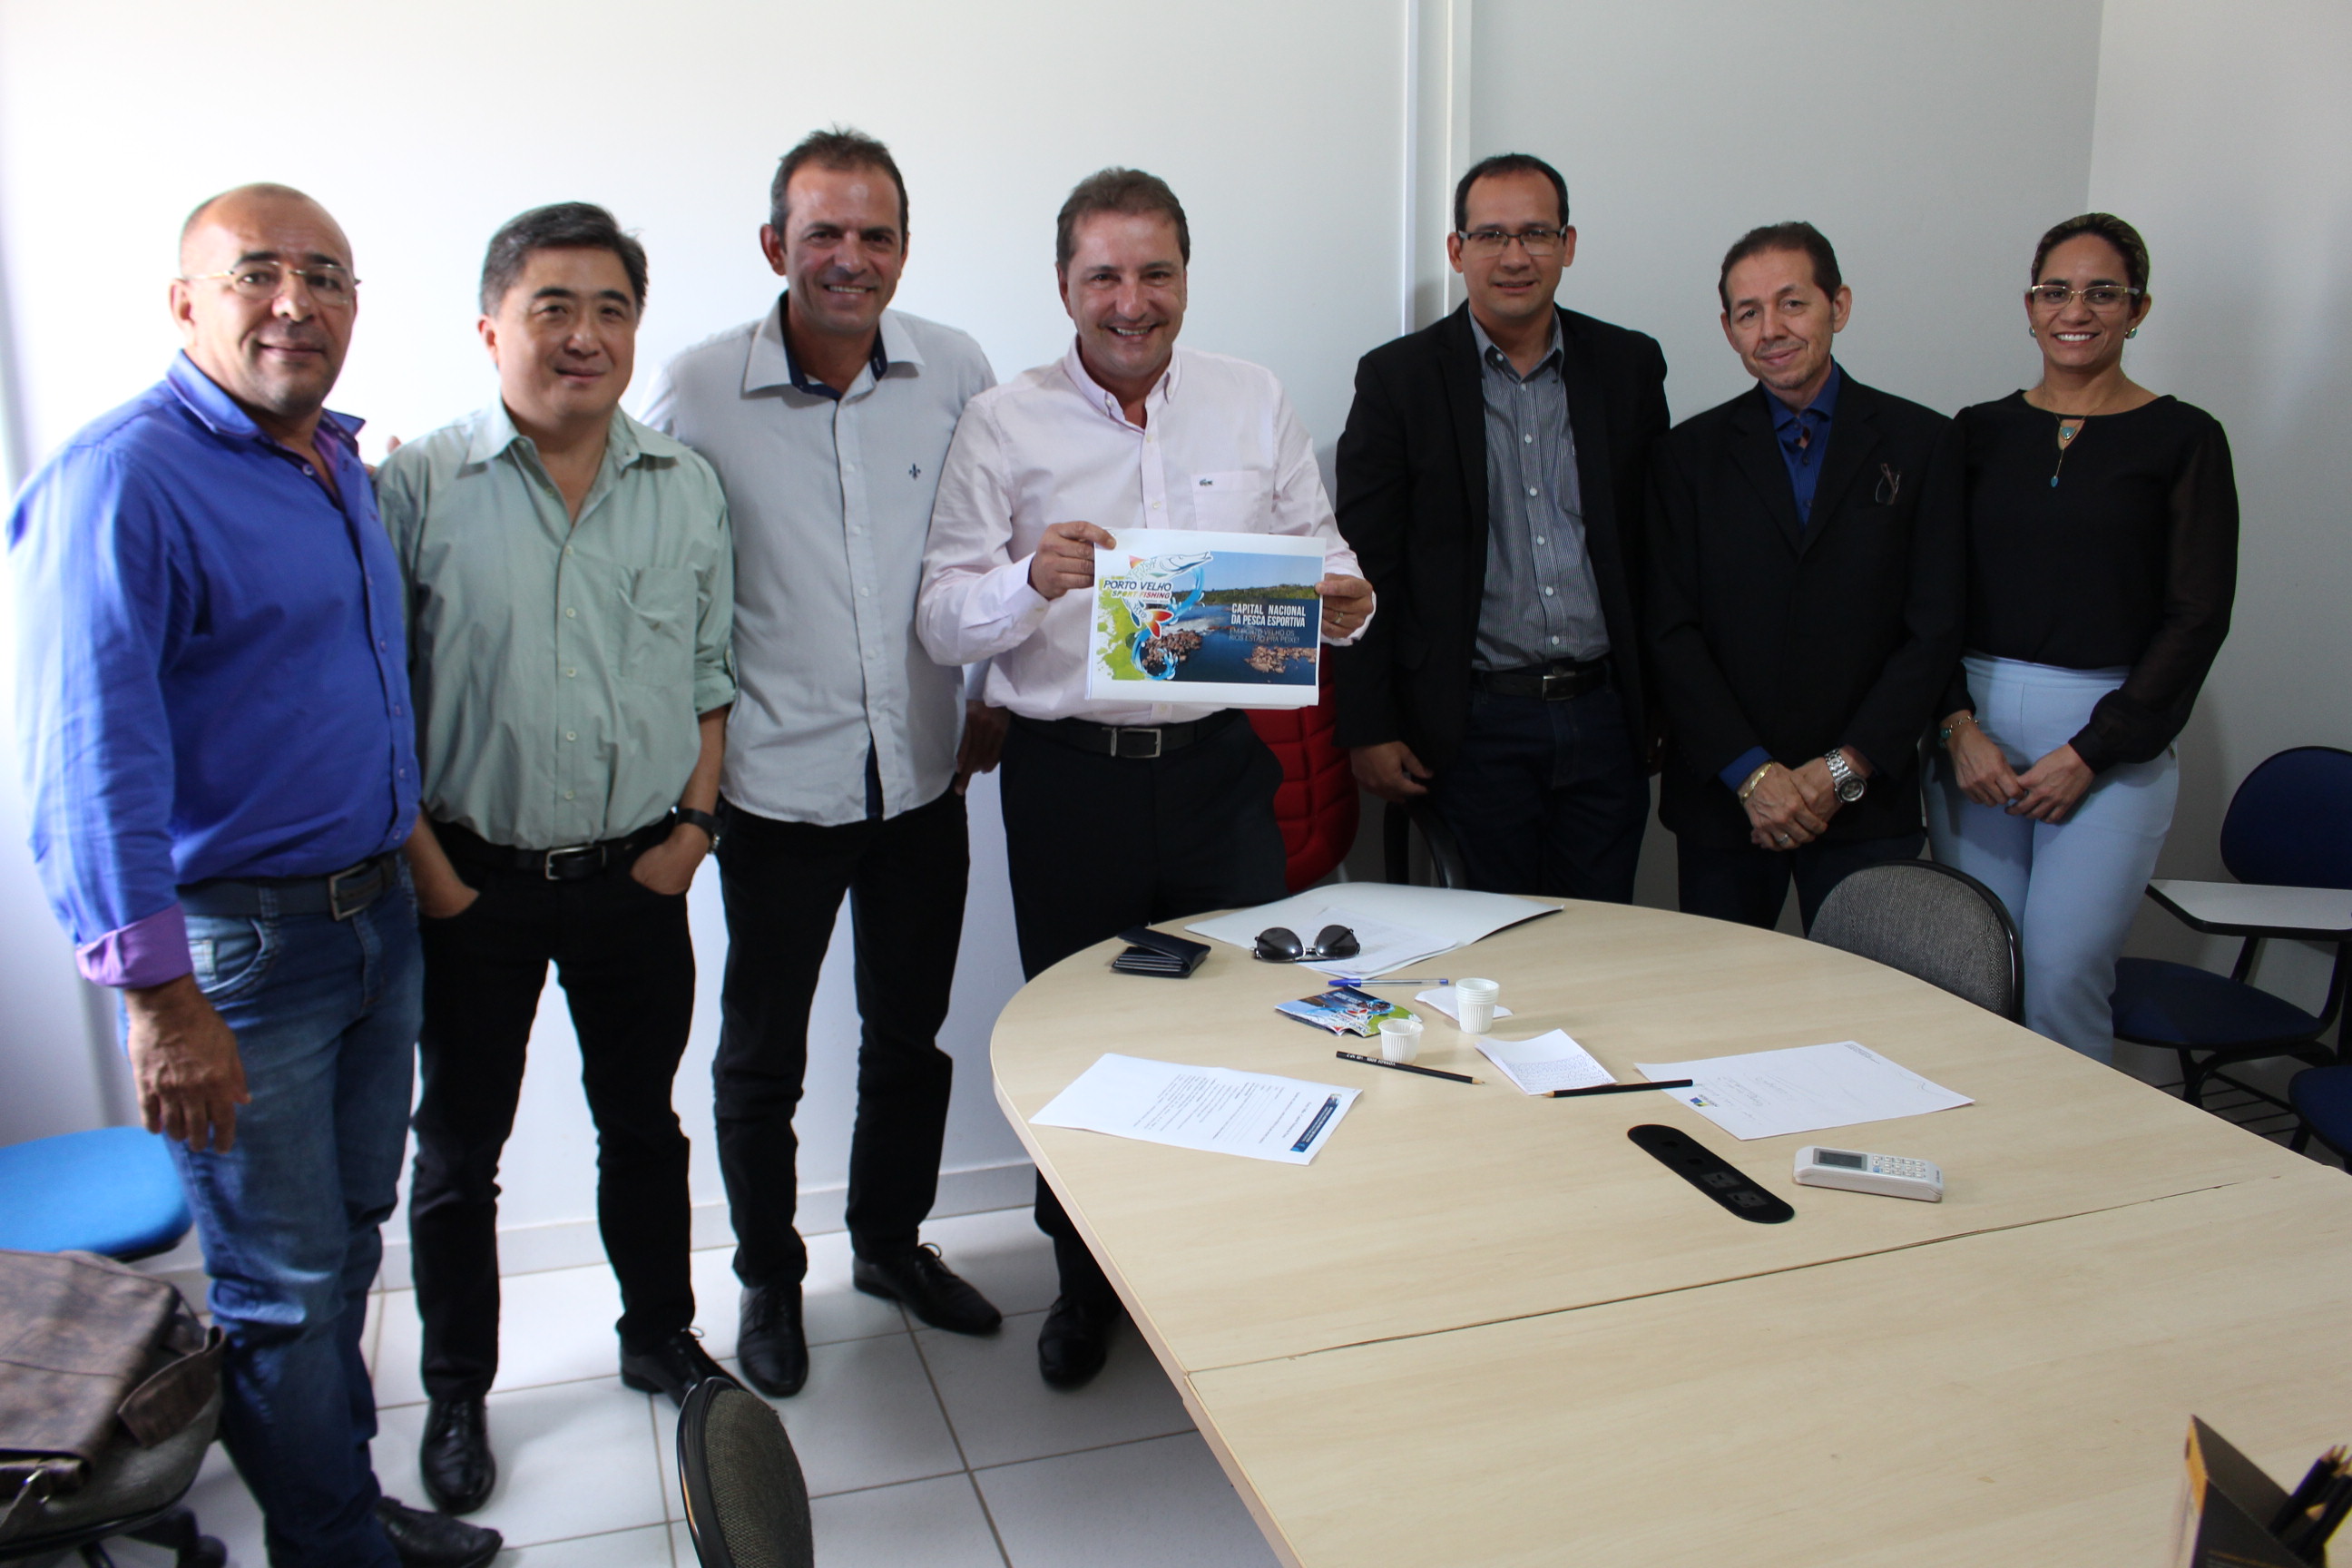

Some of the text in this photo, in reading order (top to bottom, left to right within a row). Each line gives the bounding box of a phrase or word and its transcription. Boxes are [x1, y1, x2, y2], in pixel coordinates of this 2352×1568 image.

[1103, 580, 1171, 592] PORTO VELHO
[1231, 603, 1306, 617] CAPITAL NACIONAL
[1230, 614, 1306, 628] DA PESCA ESPORTIVA
[1263, 628, 1285, 636] VELHO
[1280, 636, 1300, 644] PEIXE!
